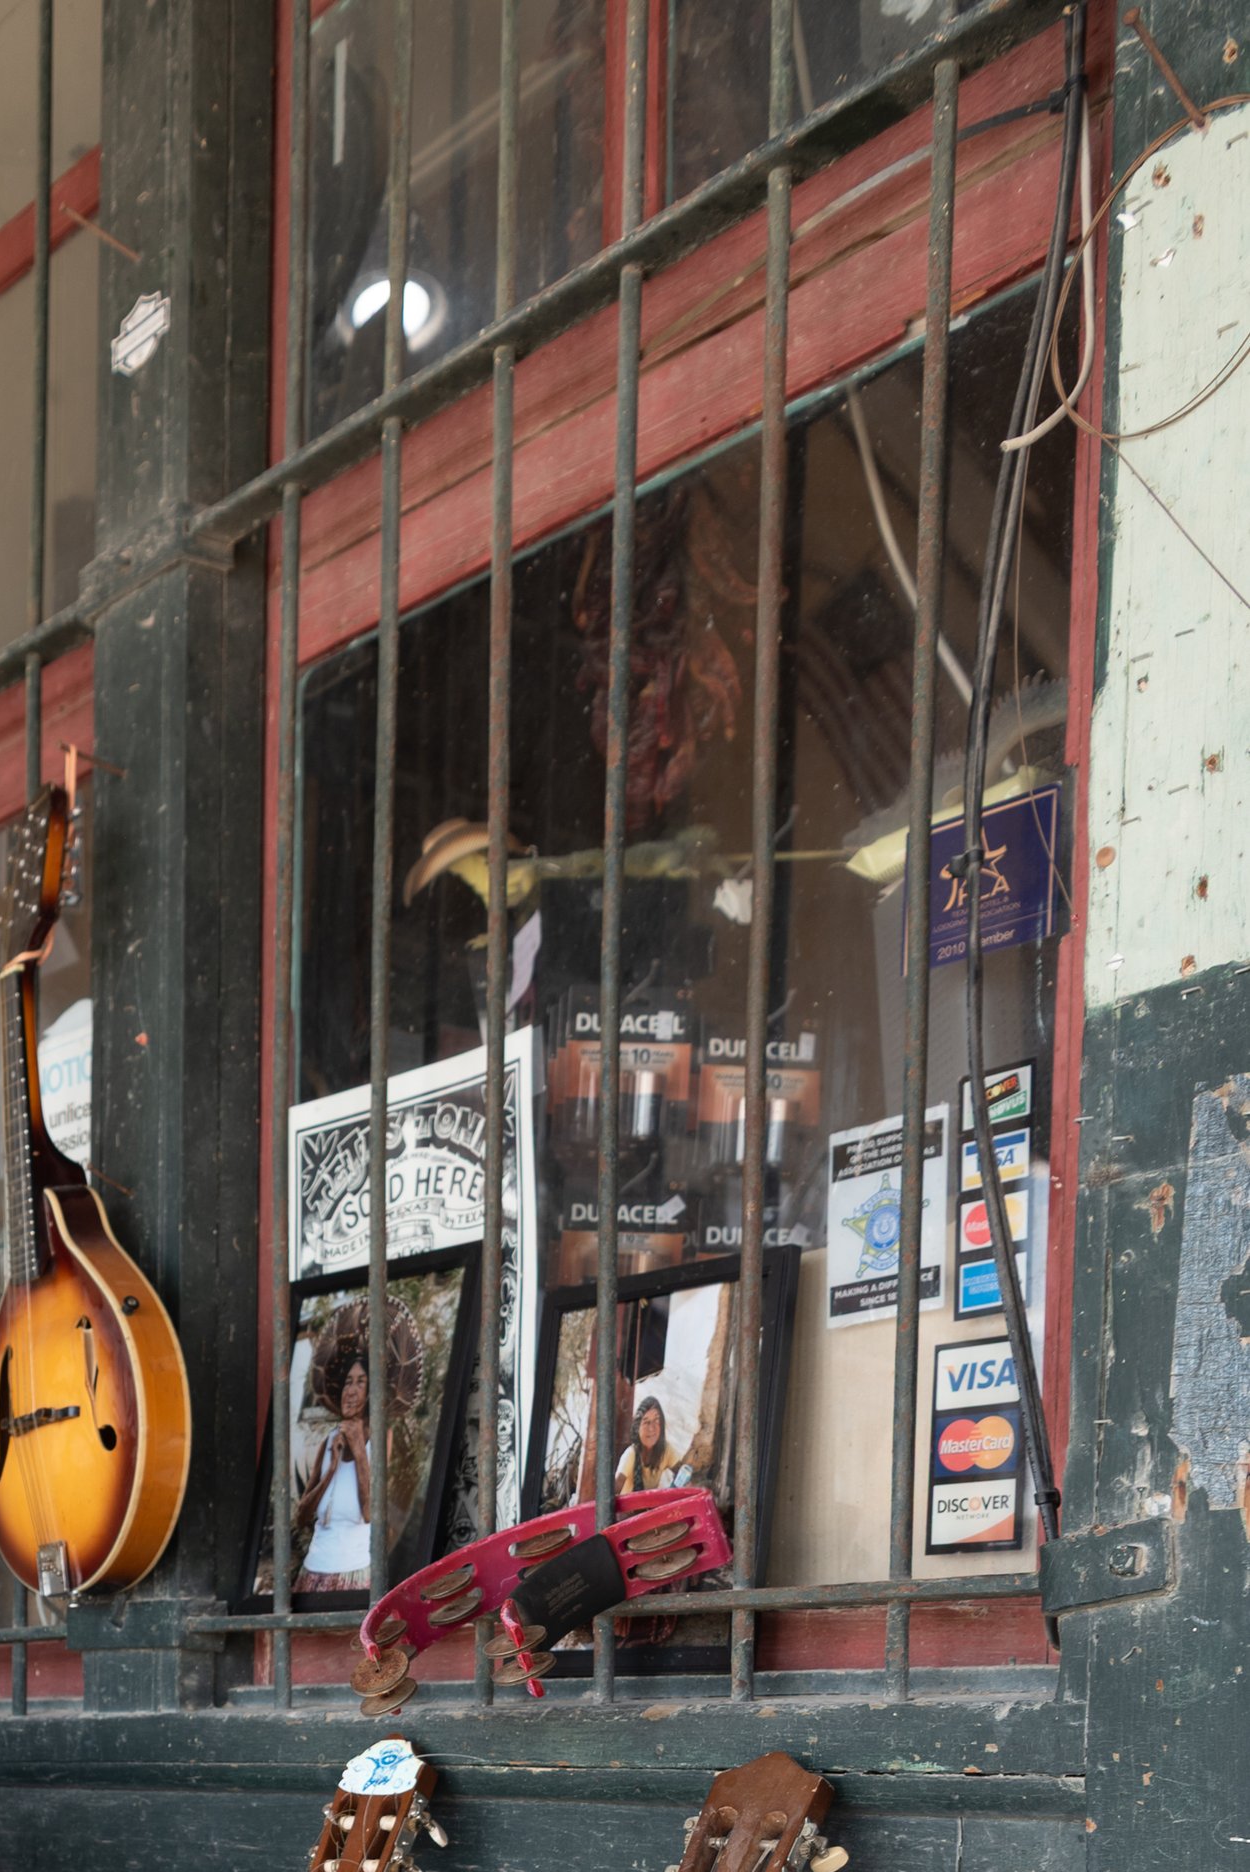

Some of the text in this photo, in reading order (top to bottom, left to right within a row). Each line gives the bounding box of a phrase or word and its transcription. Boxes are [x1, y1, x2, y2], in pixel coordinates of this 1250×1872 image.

[937, 929, 1015, 960] 2010 ember
[631, 1049, 650, 1065] 10
[342, 1165, 485, 1231] SOD HERE
[834, 1285, 869, 1300] MAKING
[870, 1282, 877, 1292] A
[859, 1294, 886, 1309] SINCE
[946, 1357, 1016, 1392] VISA
[940, 1435, 1012, 1455] MasterCard
[937, 1495, 1010, 1514] DISCOVER
[955, 1512, 990, 1521] NETWORK
